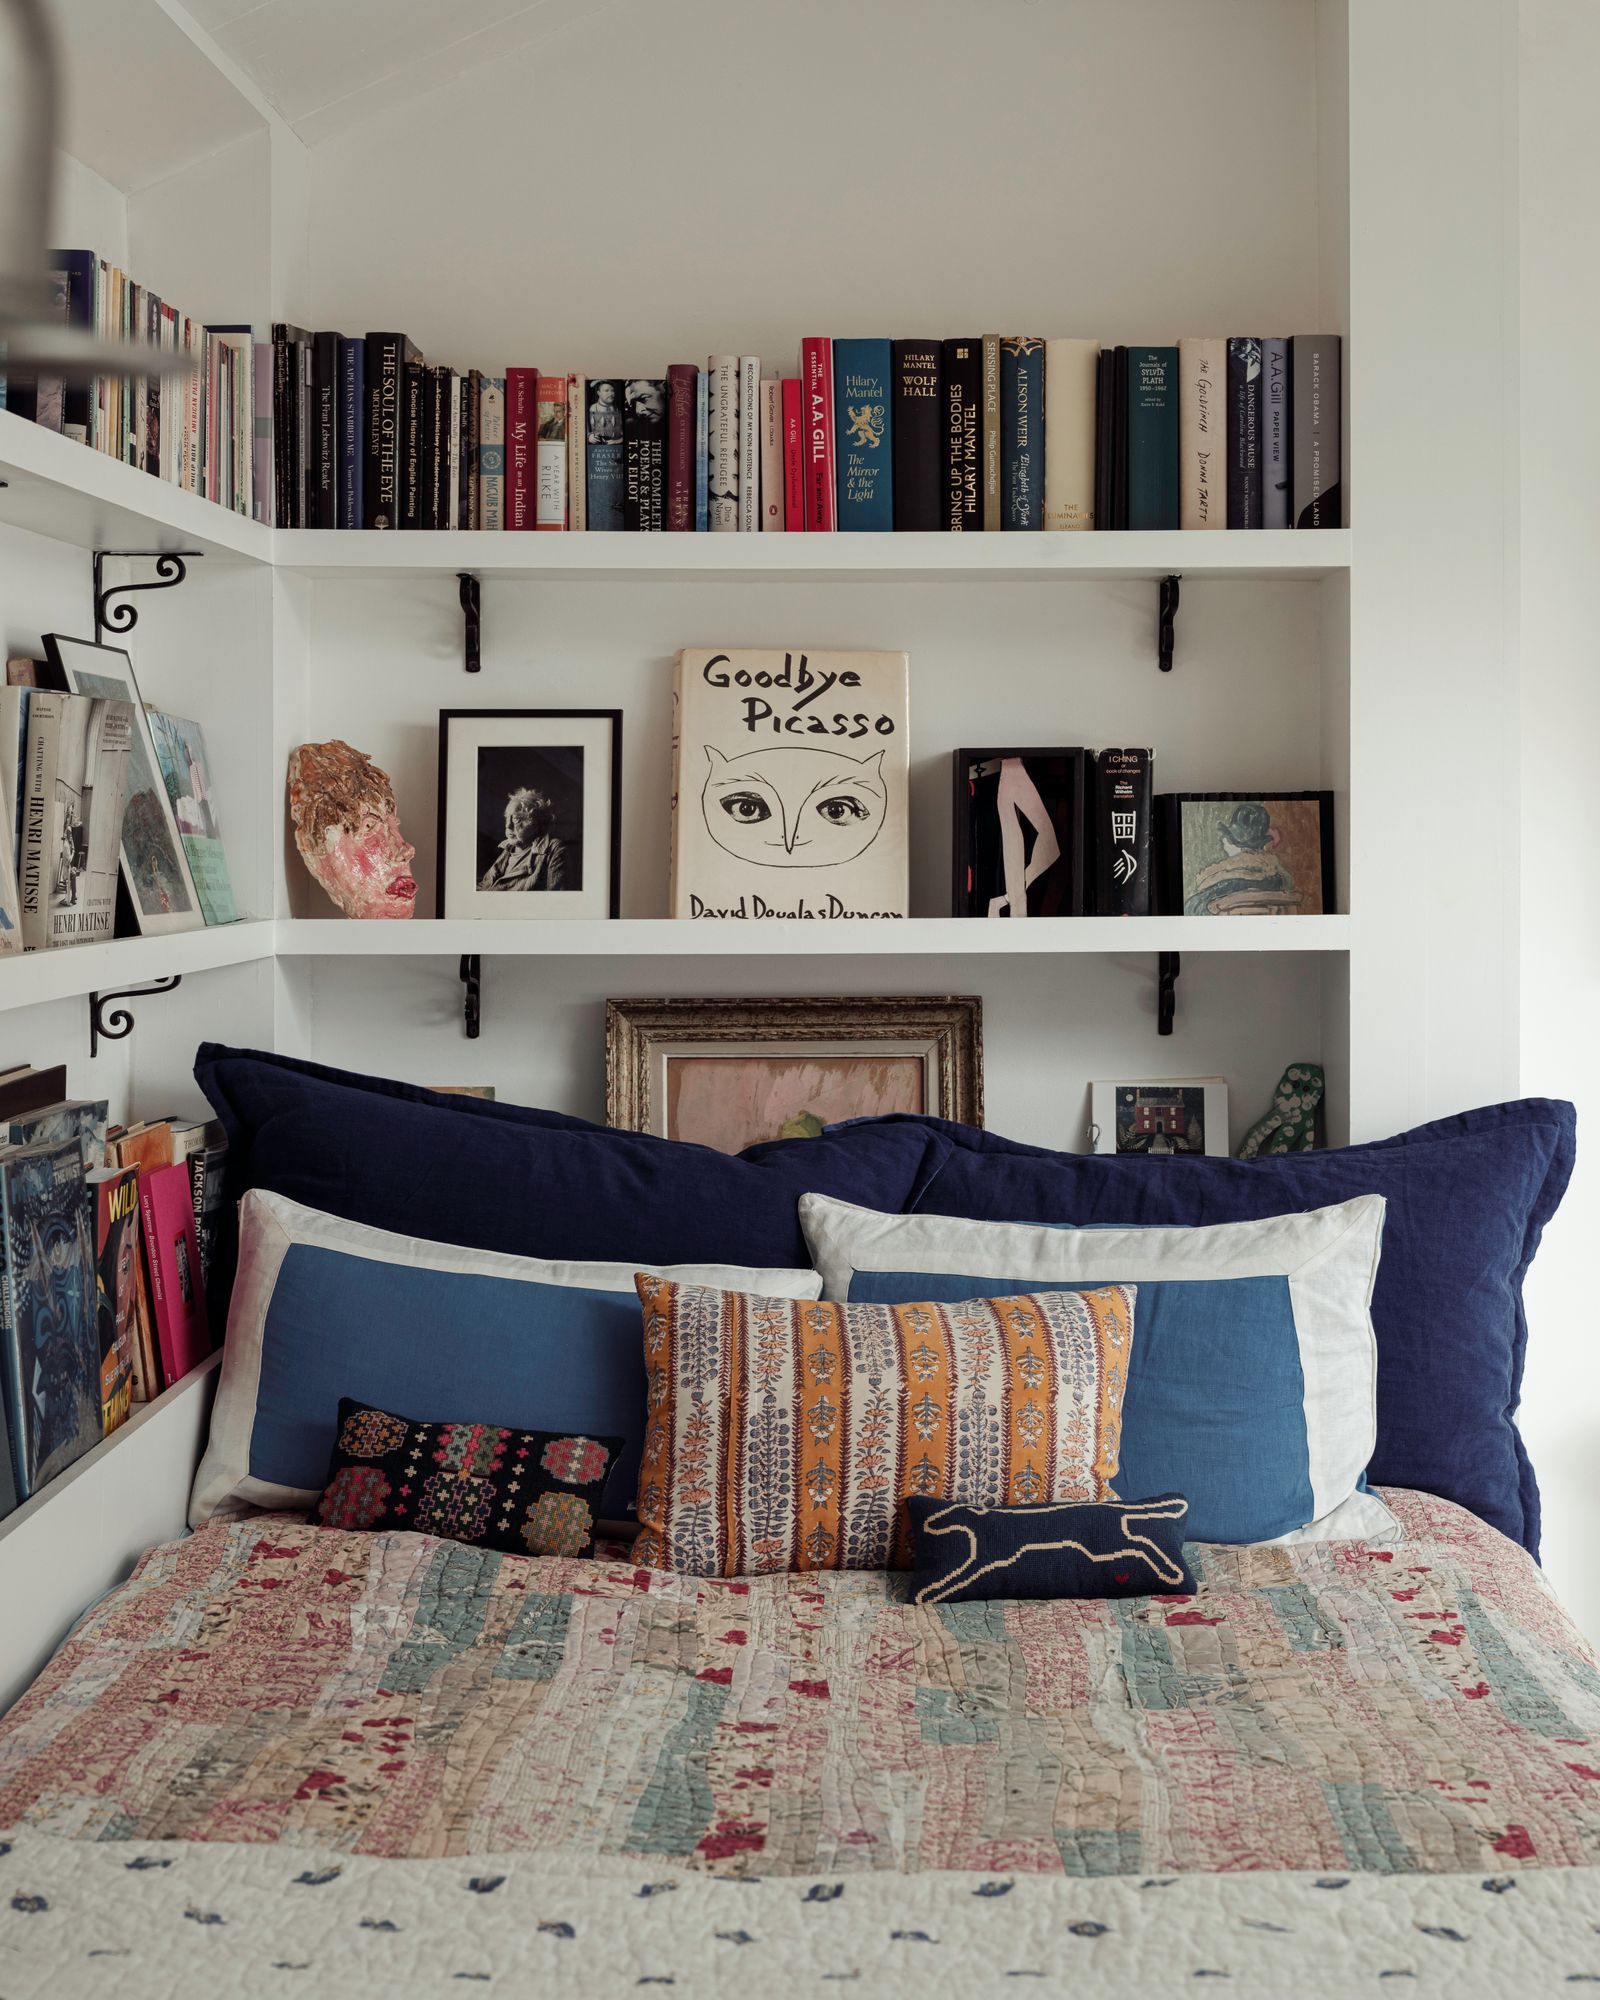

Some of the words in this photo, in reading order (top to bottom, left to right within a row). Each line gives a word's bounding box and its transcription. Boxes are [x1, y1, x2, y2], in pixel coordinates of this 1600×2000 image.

[383, 343, 395, 374] THE
[987, 342, 996, 382] SENSING
[517, 381, 525, 389] W.
[720, 365, 728, 381] THE
[846, 375, 878, 389] Hilary
[903, 376, 937, 386] WOLF
[1141, 368, 1165, 376] SYLVIA
[322, 386, 330, 401] The
[382, 378, 394, 417] SOUL
[846, 387, 883, 398] Mantel
[903, 387, 936, 397] HALL
[987, 384, 996, 412] PLACE
[1017, 368, 1027, 413] ALISON
[322, 404, 330, 421] Fran
[372, 388, 380, 428] MICHAEL
[720, 385, 728, 444] UNGRATEFUL
[747, 412, 753, 420] OF
[812, 394, 823, 426] A.A.
[950, 385, 962, 433] BODIES
[1247, 385, 1255, 440] DANGEROUS
[382, 419, 394, 438] OF
[409, 420, 417, 446] History
[512, 422, 526, 440] My
[747, 422, 753, 430] MY
[790, 418, 796, 429] AA
[964, 404, 975, 462] MANTEL
[1017, 415, 1027, 447] WEIR
[321, 424, 330, 460] Lebowitz
[371, 429, 379, 456] LEVEY
[410, 448, 416, 456] of
[628, 440, 638, 449] T.
[651, 440, 661, 464] THE
[813, 429, 824, 463] GILL
[951, 437, 962, 465] THE
[988, 430, 997, 449] Philip
[381, 443, 393, 473] THE
[515, 445, 526, 468] Life
[628, 453, 638, 462] S.
[639, 440, 650, 481] POEMS
[719, 447, 727, 486] REFUGEE
[847, 454, 865, 465] The
[1197, 451, 1211, 483] DONNA
[1247, 443, 1255, 469] MUSE
[321, 462, 330, 490] Reader
[408, 458, 416, 485] English
[541, 465, 551, 500] RILKE
[628, 467, 638, 502] ELIOT
[816, 473, 824, 485] Far
[847, 466, 879, 477] Mirror
[847, 478, 855, 488] &
[859, 478, 874, 487] the
[951, 468, 962, 486] UP
[988, 451, 997, 494] Gumuchdjian
[1019, 454, 1029, 493] Elizabeth
[380, 475, 392, 503] EYE
[407, 486, 416, 517] Painting
[640, 485, 649, 496] &
[816, 488, 824, 502] and
[847, 489, 873, 502] Light
[964, 464, 976, 513] HILARY
[515, 489, 526, 527] Indian
[715, 502, 723, 526] Nayeri
[724, 506, 732, 522] Dina
[816, 503, 824, 524] Away
[950, 491, 962, 532] BRING
[1017, 498, 1029, 526] York
[1196, 487, 1208, 522] TARTT
[702, 652, 862, 712] Goodbye
[741, 696, 895, 739] Picasso
[34, 736, 44, 772] CHATTING
[34, 773, 43, 793] WITH
[28, 797, 45, 847] HENRI
[23, 850, 41, 914] MATISSE
[690, 894, 746, 919] David
[826, 894, 904, 919] Duncan
[53, 913, 78, 935] HENRI
[78, 912, 110, 932] MATISSE
[193, 1160, 204, 1212] JACKSON
[108, 1176, 138, 1225] WILD
[143, 1195, 151, 1208] Lucy
[145, 1209, 153, 1233] Sparrow
[149, 1235, 157, 1258] Bourdon
[151, 1259, 159, 1277] Street
[154, 1277, 163, 1300] Chemist
[1, 1275, 12, 1329] CHALLENGING
